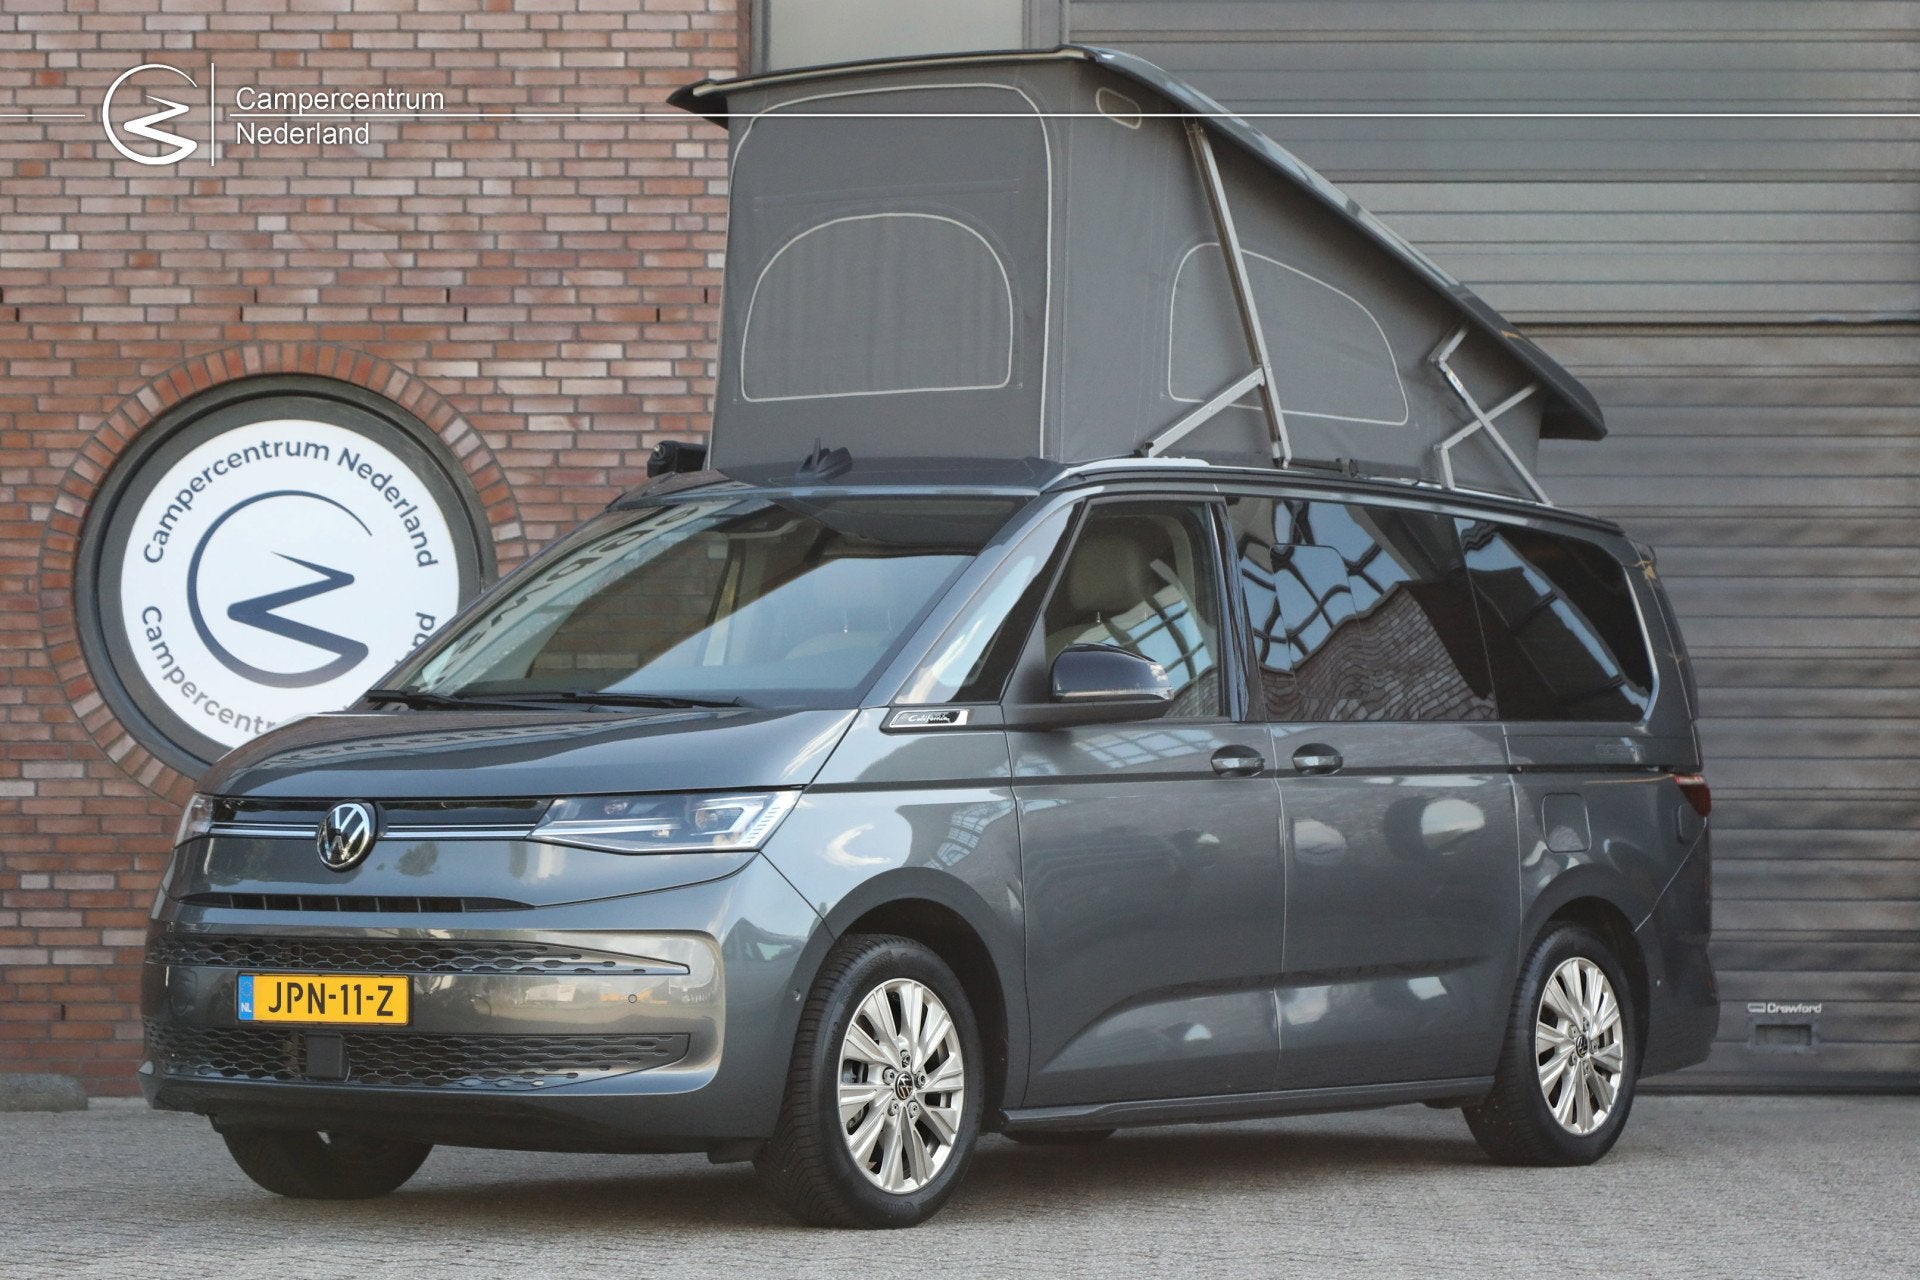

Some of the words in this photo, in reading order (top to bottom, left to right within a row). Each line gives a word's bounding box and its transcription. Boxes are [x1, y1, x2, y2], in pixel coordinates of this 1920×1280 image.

[143, 440, 330, 563] Campercentrum
[337, 447, 439, 567] Nederland
[142, 606, 276, 735] Campercentr
[908, 713, 951, 724] California
[240, 1002, 252, 1013] NL
[268, 981, 394, 1017] JPN-11-Z
[1767, 1002, 1822, 1014] Crawford
